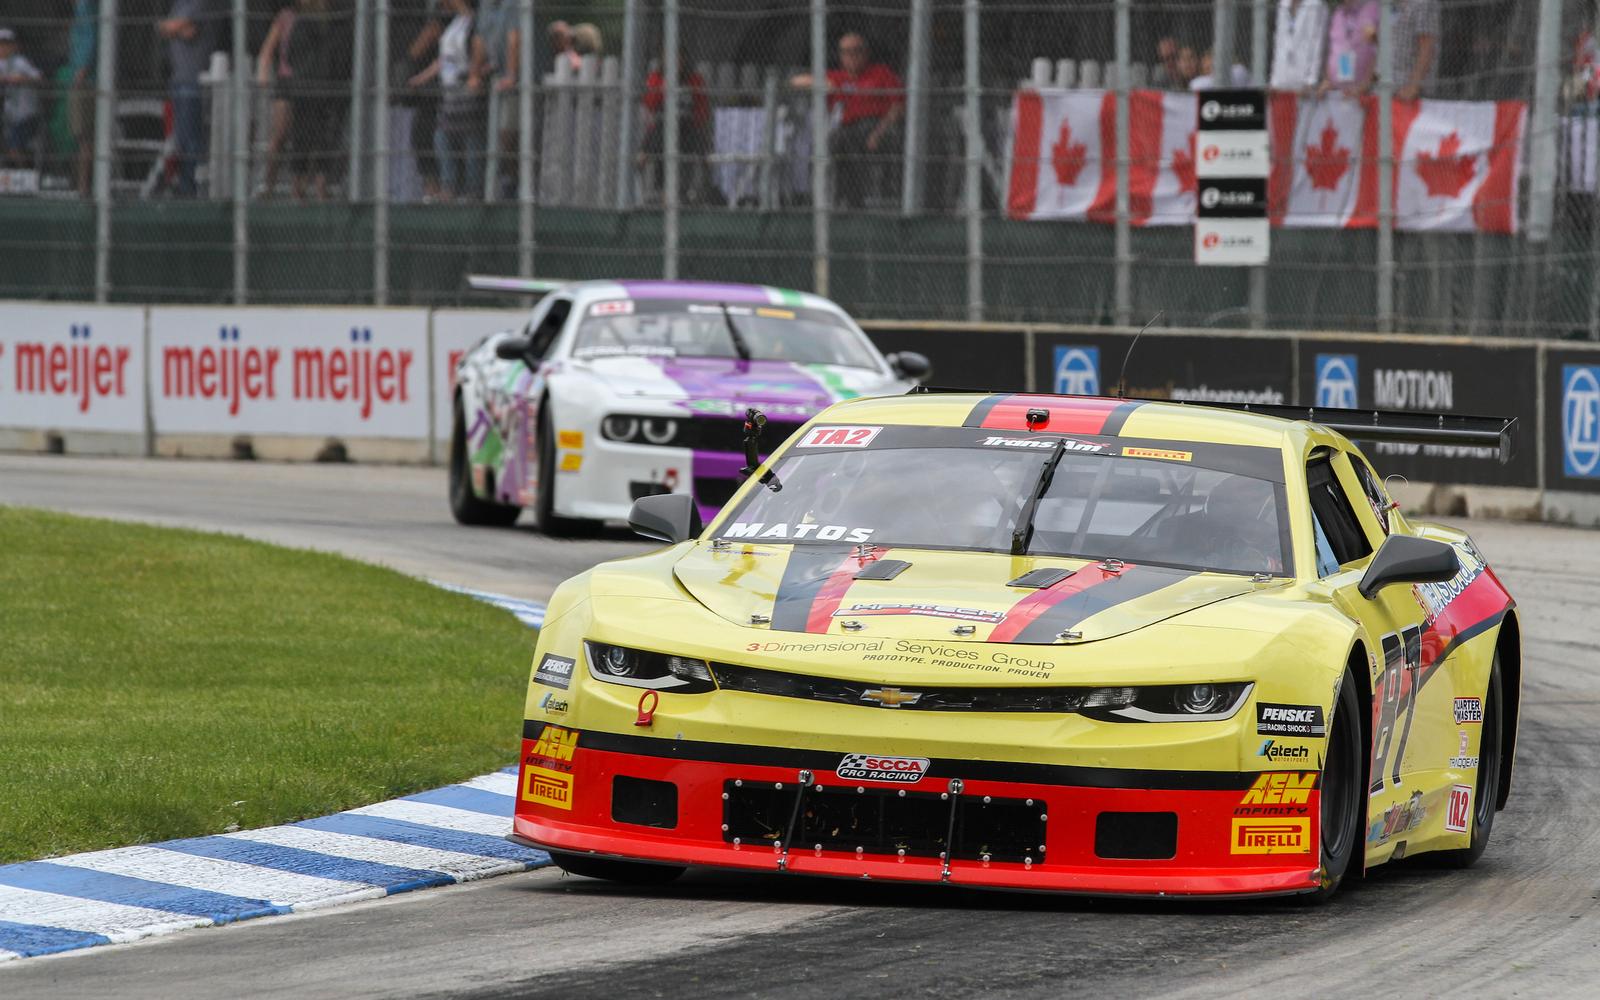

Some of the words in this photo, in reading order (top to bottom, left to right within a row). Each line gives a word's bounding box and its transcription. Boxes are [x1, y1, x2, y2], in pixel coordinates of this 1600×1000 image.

[15, 324, 130, 413] meijer
[163, 326, 280, 416] meijer
[293, 327, 412, 420] meijer
[1373, 369, 1453, 409] MOTION
[810, 429, 872, 445] TA2
[1128, 448, 1186, 459] PIRELLI
[722, 522, 874, 543] MATOS
[541, 658, 573, 675] PENSKE
[746, 640, 884, 652] 3-Dimensional
[895, 640, 979, 661] Services
[991, 652, 1056, 671] Group
[862, 654, 927, 665] PROTOTYPE.
[930, 659, 1002, 674] PRODUCTION.
[1007, 667, 1051, 680] PROVEN
[1262, 708, 1316, 723] PENSKE
[1267, 723, 1287, 732] RACING
[1287, 724, 1311, 733] SHOCKS
[531, 725, 580, 762] AEM
[1259, 740, 1309, 762] Katech
[525, 756, 573, 772] INFINITY
[840, 768, 867, 777] PRO
[869, 771, 919, 781] RACING
[866, 758, 922, 772] SCCA
[528, 773, 569, 803] PIRELLI
[1240, 773, 1318, 805] AEM
[1233, 807, 1309, 816] INFINITY
[1448, 790, 1469, 828] TA2
[1238, 825, 1303, 848] PIRELLI
